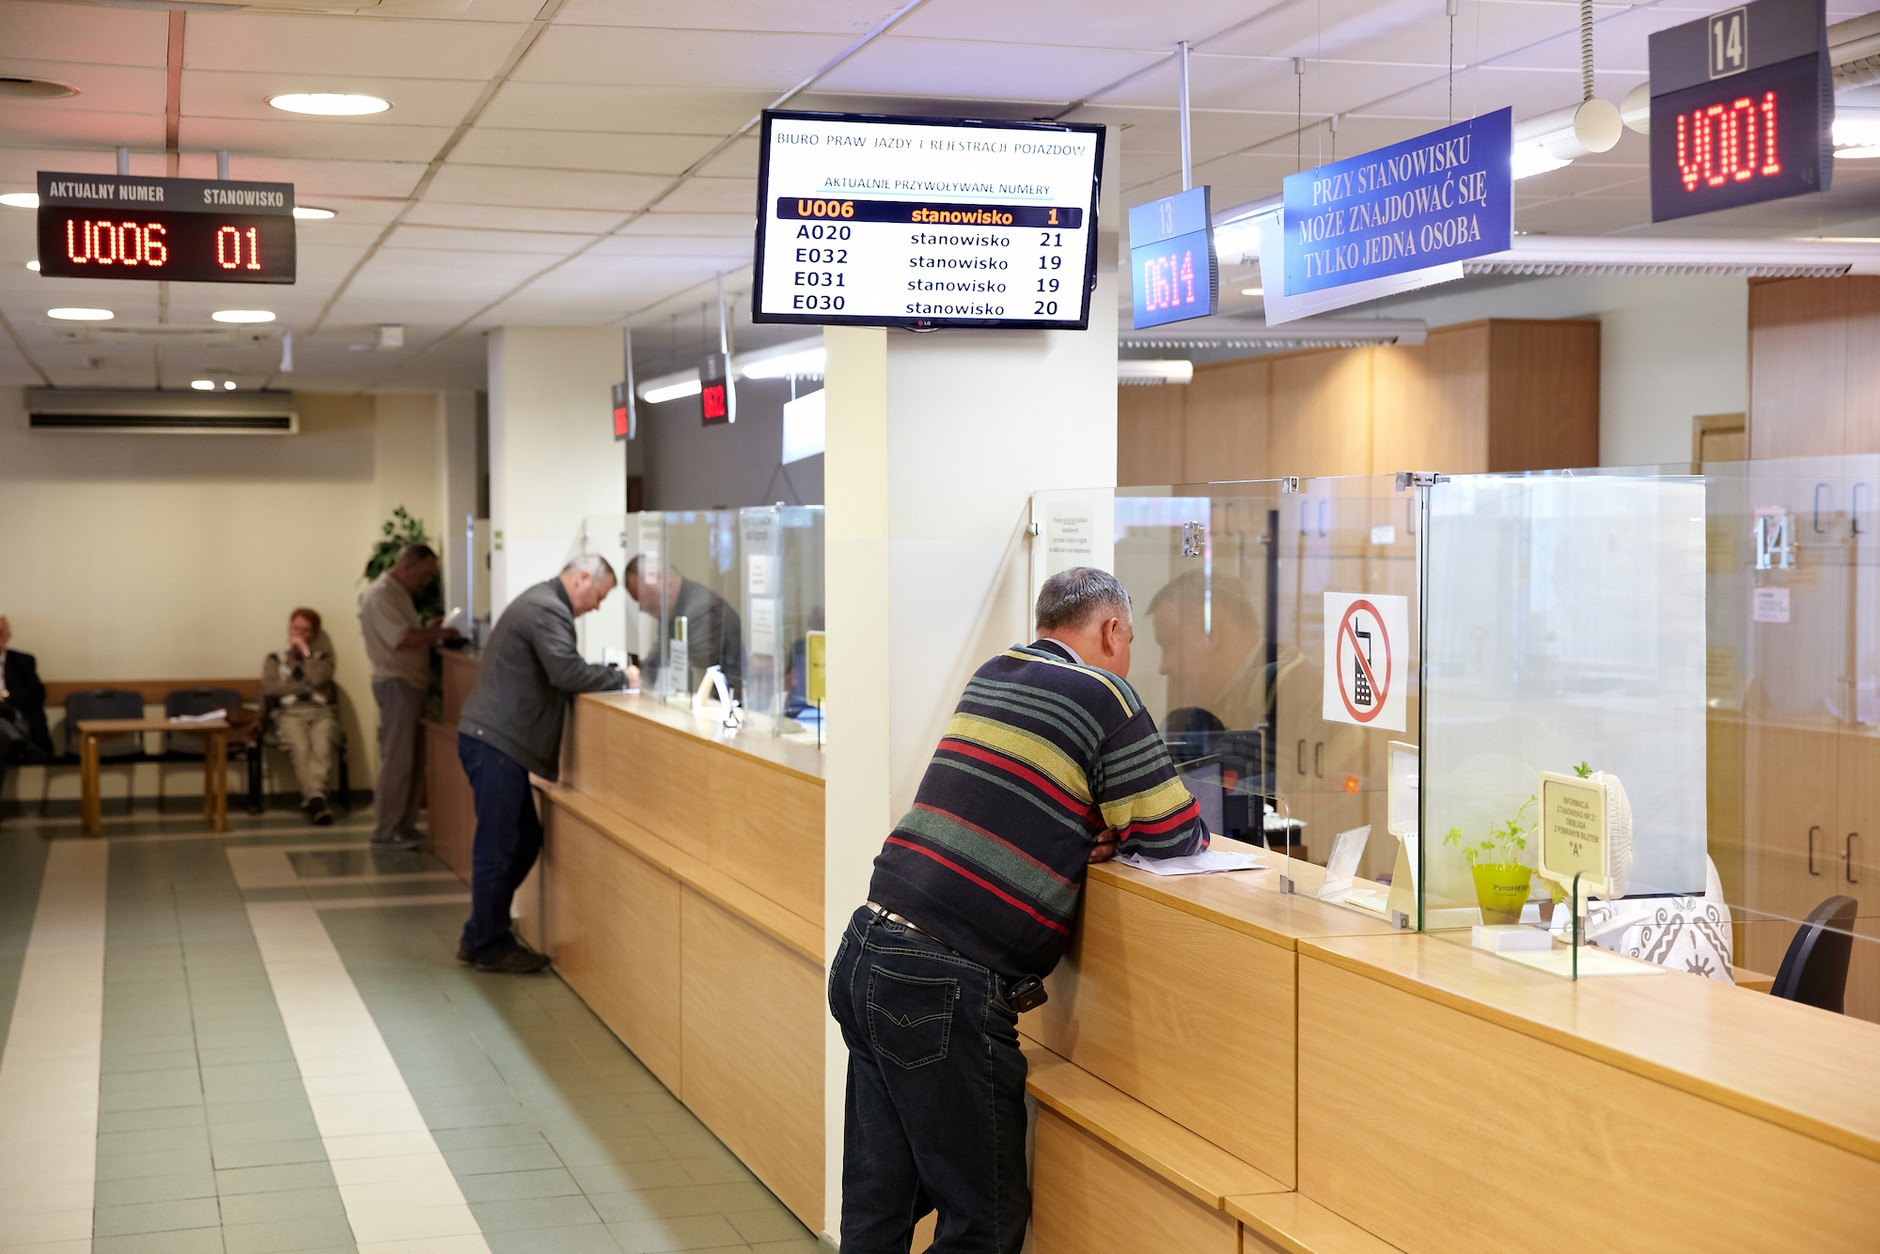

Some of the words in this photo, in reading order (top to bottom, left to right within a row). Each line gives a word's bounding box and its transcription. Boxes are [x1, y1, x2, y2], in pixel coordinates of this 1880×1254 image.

[1714, 15, 1743, 71] 14
[777, 132, 819, 145] BIURO
[827, 134, 867, 147] PRAW
[873, 137, 913, 149] JAZDY
[930, 139, 1007, 153] REJESTRACJI
[1677, 91, 1782, 192] V001
[1312, 171, 1354, 207] PRZY
[1358, 134, 1471, 194] STANOWISKU
[50, 181, 115, 200] AKTUALNY
[119, 185, 164, 202] NUMER
[203, 188, 284, 207] STANOWISKO
[824, 177, 890, 190] AKTUALNIE
[894, 179, 994, 193] PRZYWOŁYWANE
[999, 183, 1050, 195] NUMERY
[797, 199, 855, 218] U006
[911, 207, 1013, 225] stanowisko
[1047, 208, 1059, 224] 1
[1160, 202, 1173, 235] 13
[1299, 206, 1346, 245] MOŻE
[1349, 171, 1455, 232] ZNAJDOWAĆ
[1458, 170, 1487, 207] SIĘ
[67, 219, 167, 267] U006
[217, 225, 261, 270] 01
[796, 224, 852, 241] A020
[910, 232, 1011, 247] stanowisko
[1039, 232, 1063, 247] 21
[1304, 243, 1359, 279] TYLKO
[1362, 229, 1416, 266] JEDNA
[1420, 214, 1481, 253] OSOBA
[795, 248, 848, 264] E032
[909, 255, 1009, 271] stanowisko
[1038, 255, 1062, 270] 19
[794, 271, 846, 287] E031
[907, 278, 1007, 294] stanowisko
[1036, 278, 1060, 293] 19
[792, 294, 845, 310] E030
[905, 301, 1004, 316] stanowisko
[1033, 300, 1058, 315] 20
[1753, 516, 1791, 570] 14
[1556, 805, 1583, 819] STANOWISKO
[1563, 796, 1589, 809] INFORMACJA
[1557, 825, 1580, 838] POBRANYM
[1580, 832, 1598, 843] BILETEM
